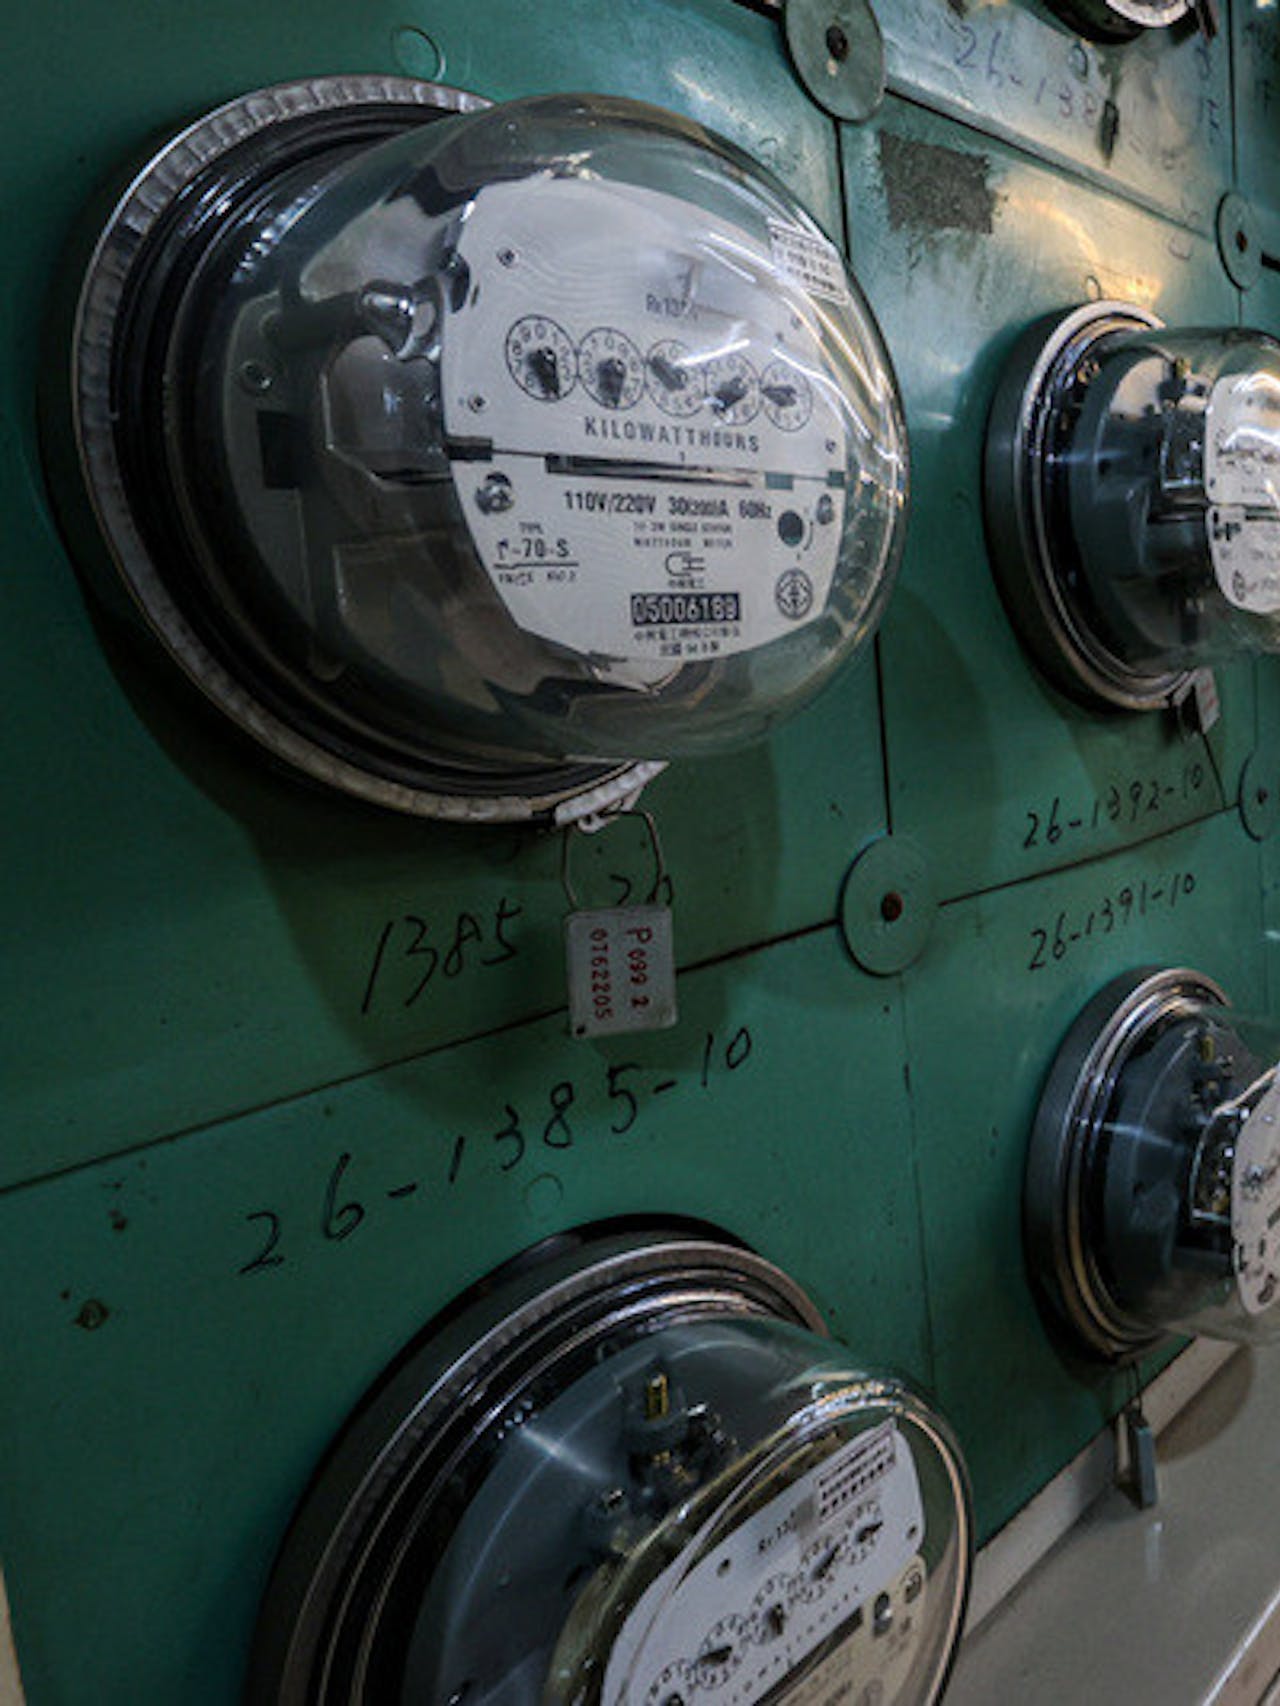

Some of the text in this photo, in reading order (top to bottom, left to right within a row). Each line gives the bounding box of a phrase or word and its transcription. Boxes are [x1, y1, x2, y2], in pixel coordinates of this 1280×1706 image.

[584, 416, 760, 453] KILOWATTHOURS
[361, 898, 523, 1014] 1385
[1028, 872, 1196, 971] 26-1391-10
[240, 1027, 752, 1275] 26-1385-10
